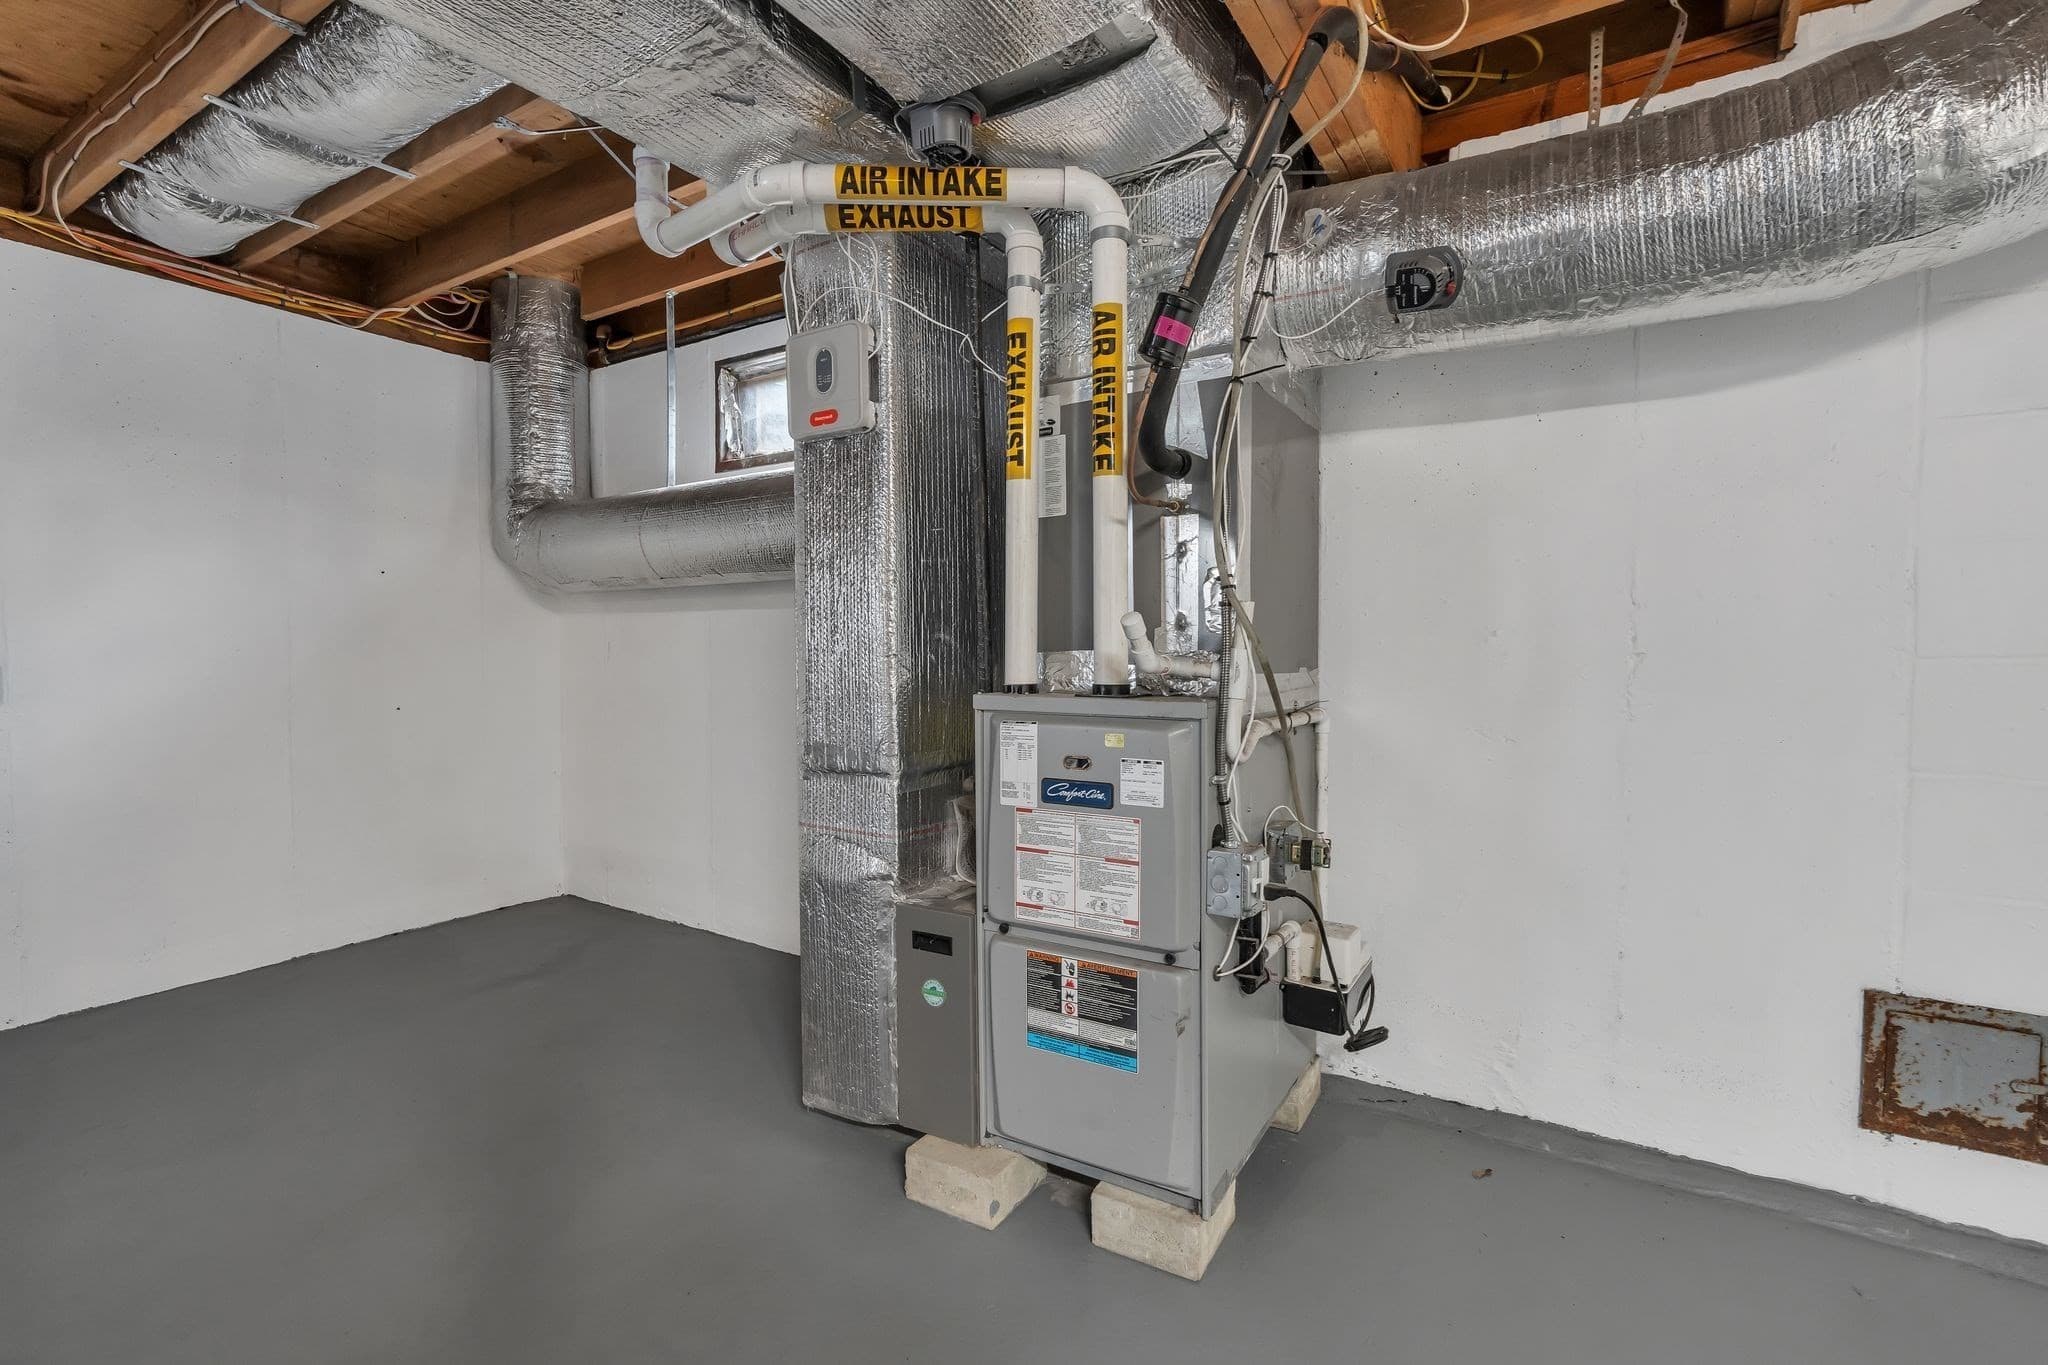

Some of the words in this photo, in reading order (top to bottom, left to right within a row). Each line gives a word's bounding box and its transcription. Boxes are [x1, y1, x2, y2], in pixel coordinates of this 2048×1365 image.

[840, 166, 888, 195] AIR
[899, 167, 1003, 197] INTAKE
[838, 204, 971, 229] EXHAUST
[1093, 311, 1116, 359] AIR
[1007, 332, 1027, 467] EXHAUST
[1093, 366, 1116, 472] INTAKE
